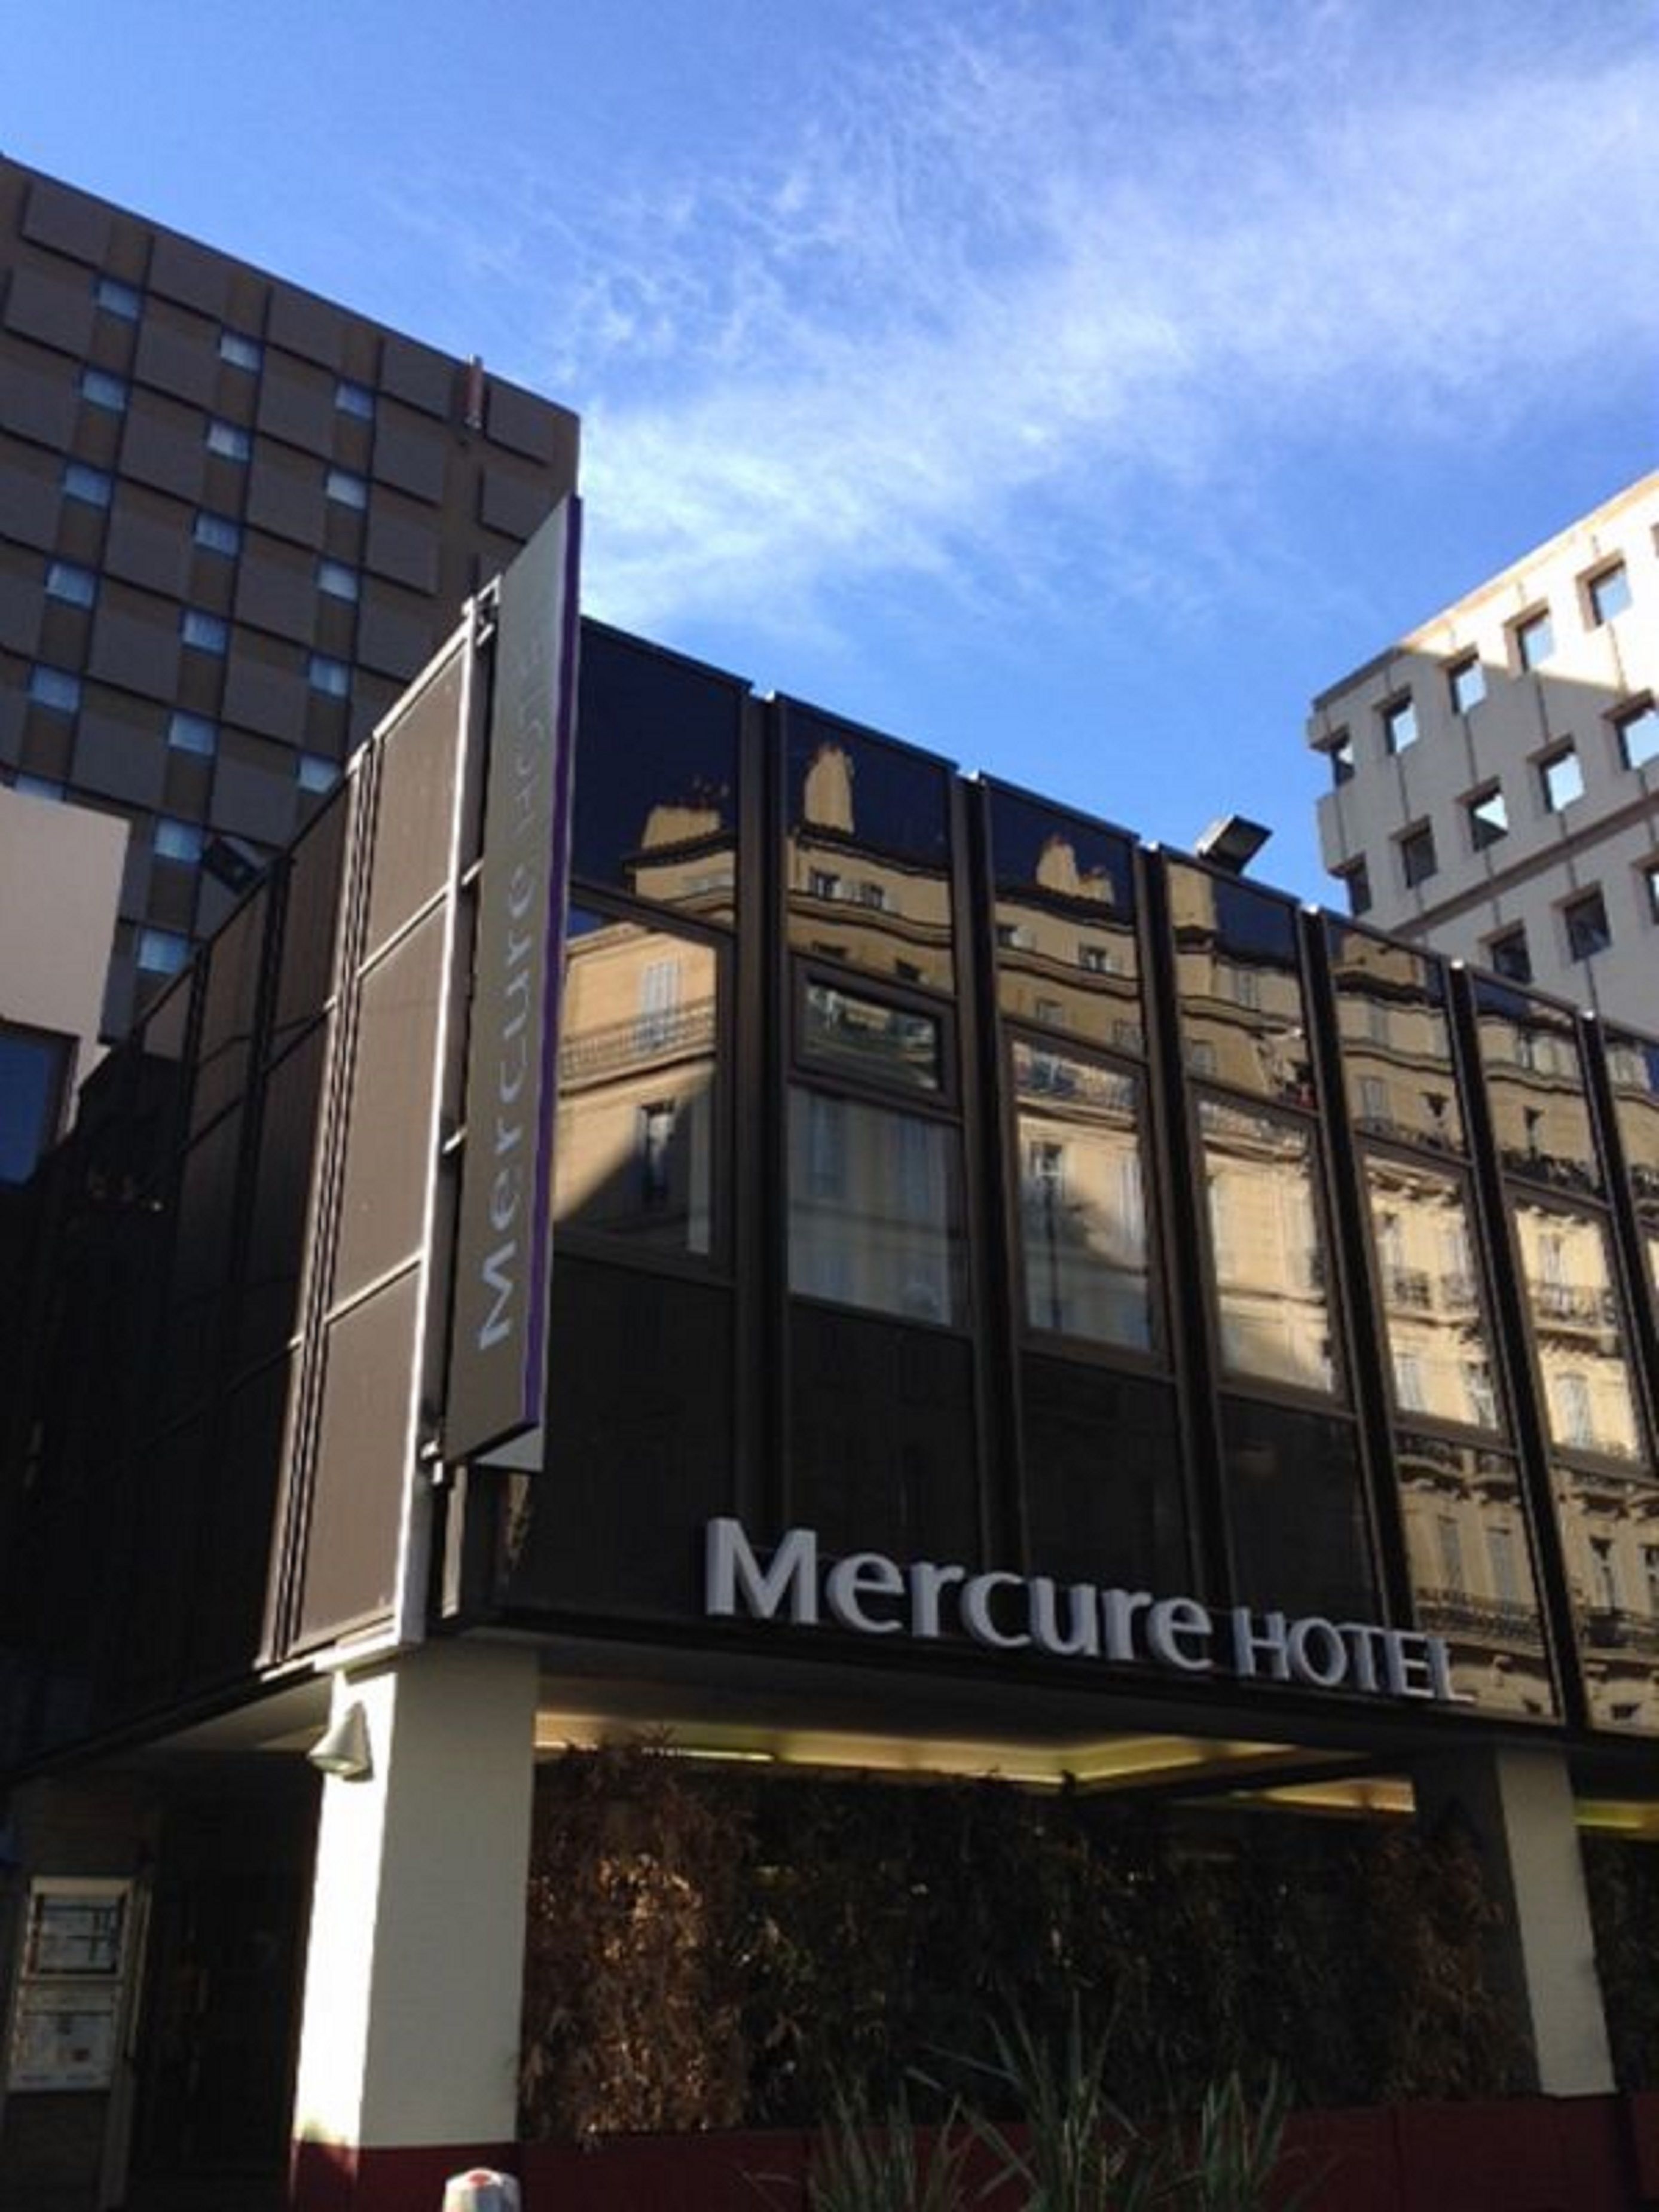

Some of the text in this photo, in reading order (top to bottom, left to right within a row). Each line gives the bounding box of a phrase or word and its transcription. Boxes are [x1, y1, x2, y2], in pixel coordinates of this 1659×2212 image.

[479, 864, 533, 1350] Mercure
[705, 1517, 1475, 1703] Mercure HOTEL
